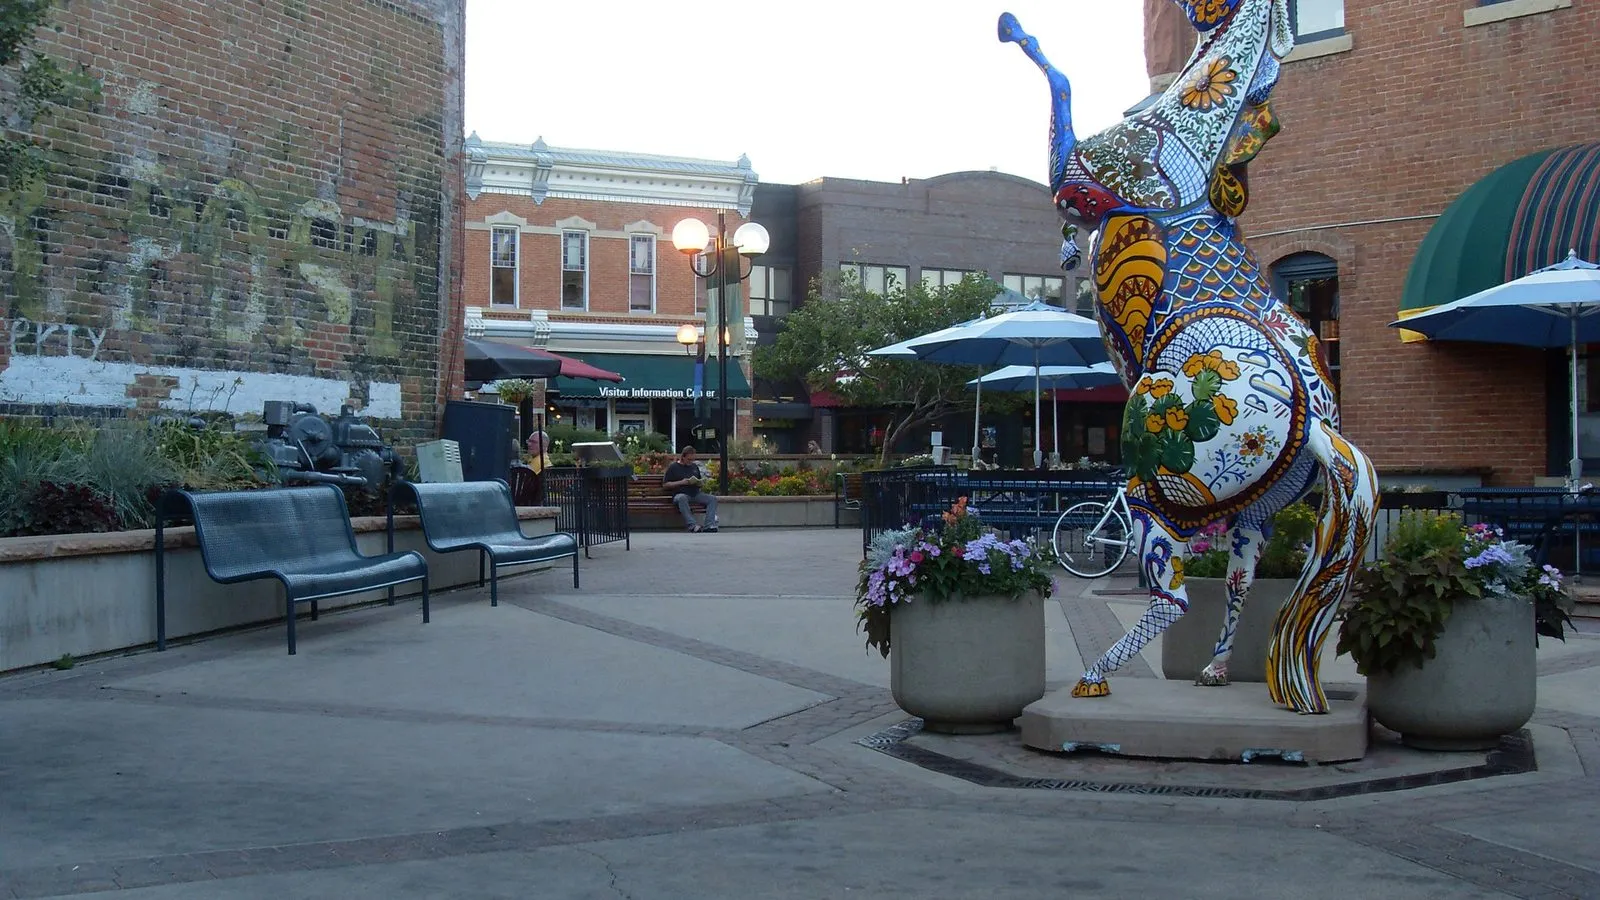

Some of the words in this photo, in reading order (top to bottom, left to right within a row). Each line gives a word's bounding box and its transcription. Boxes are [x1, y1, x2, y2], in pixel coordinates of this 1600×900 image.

[599, 387, 629, 397] Visitor
[632, 387, 684, 398] Information
[686, 388, 716, 398] Cer
